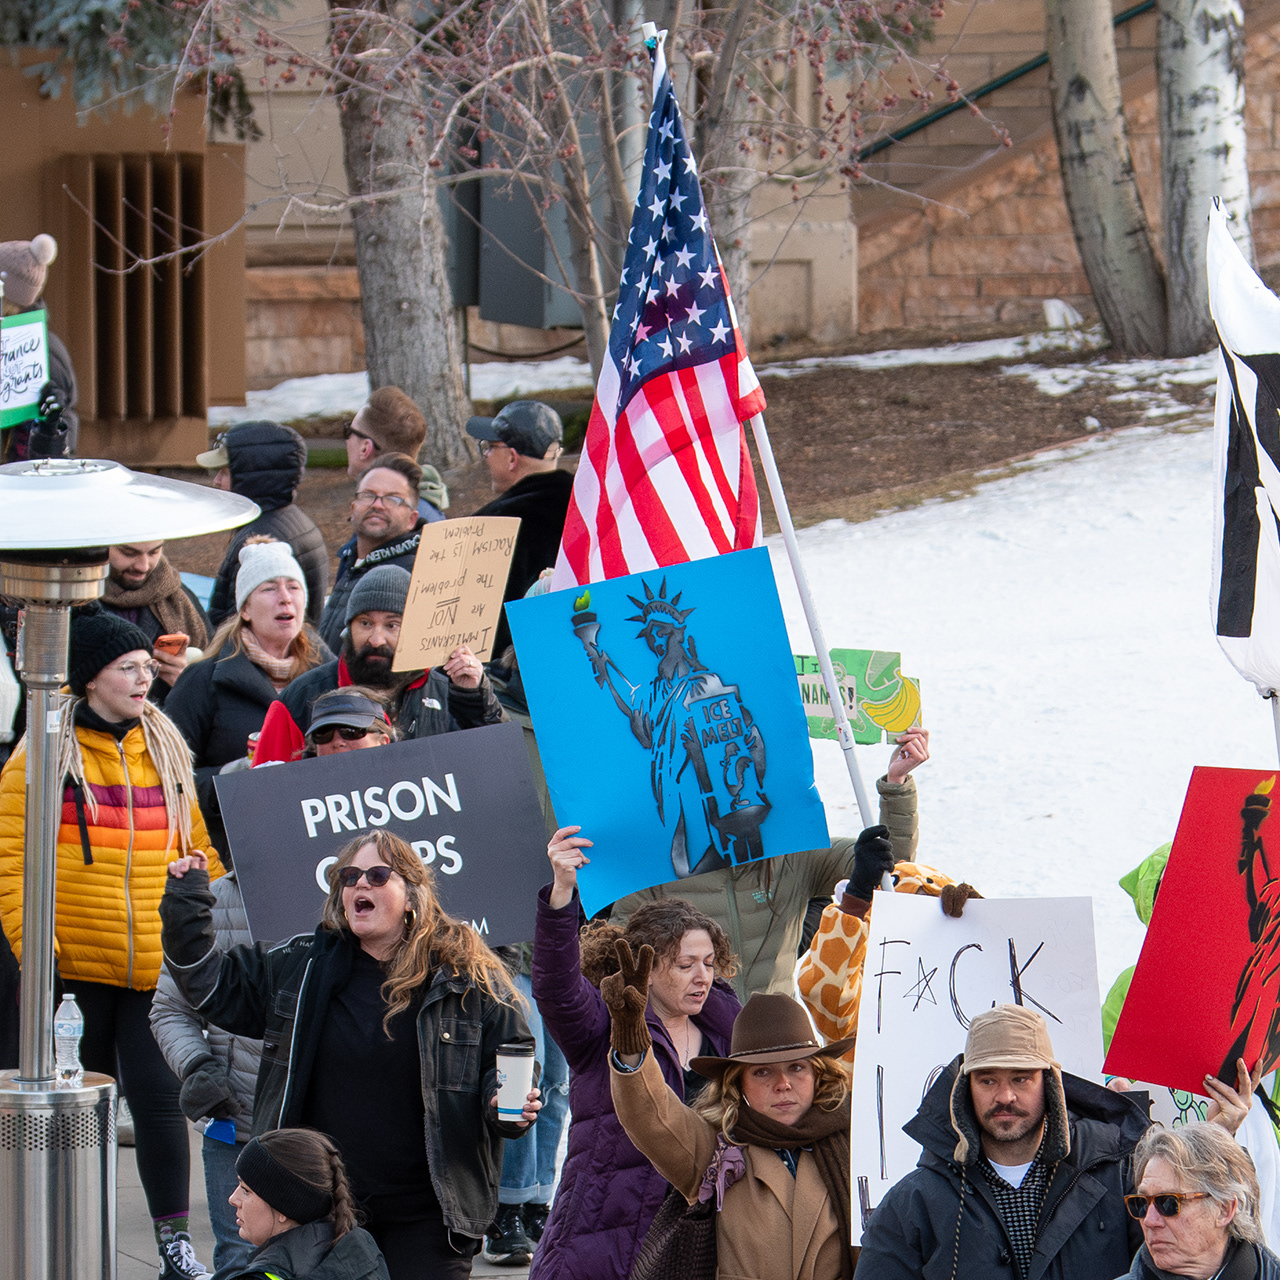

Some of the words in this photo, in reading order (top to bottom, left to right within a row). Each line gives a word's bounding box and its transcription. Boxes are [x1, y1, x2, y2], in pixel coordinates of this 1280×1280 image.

[0, 337, 40, 362] rance
[0, 362, 43, 402] grants
[427, 603, 458, 629] NOT
[702, 699, 732, 723] ICE
[702, 717, 743, 748] MELT
[300, 773, 461, 838] PRISON
[315, 834, 463, 895] CPS
